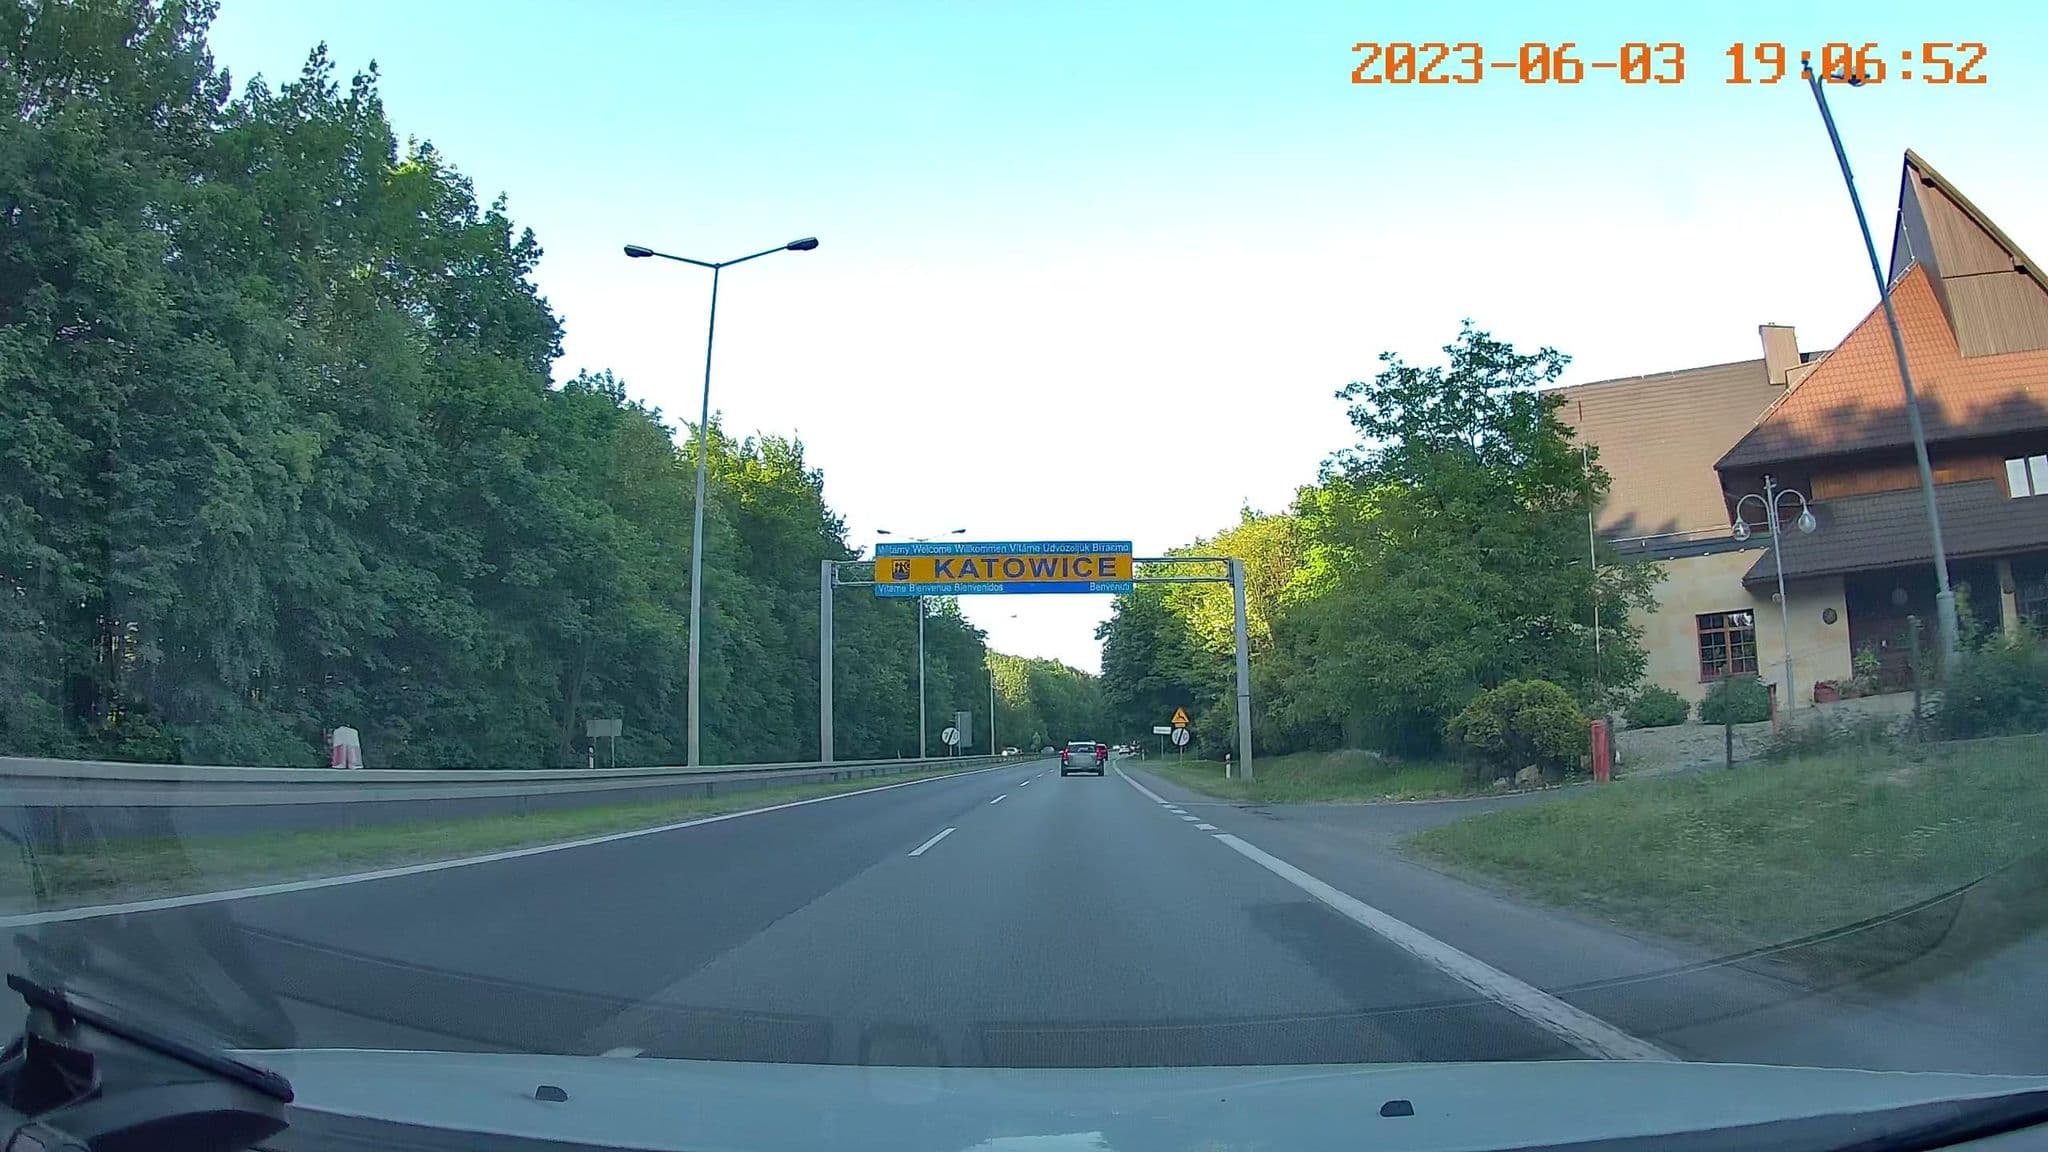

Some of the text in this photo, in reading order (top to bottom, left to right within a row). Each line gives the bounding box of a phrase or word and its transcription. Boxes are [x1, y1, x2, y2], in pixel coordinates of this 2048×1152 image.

[912, 544, 952, 553] Welcome
[955, 543, 1006, 553] Willkommen
[935, 557, 1117, 578] KATOWICE
[954, 582, 1003, 592] Bienvenidos
